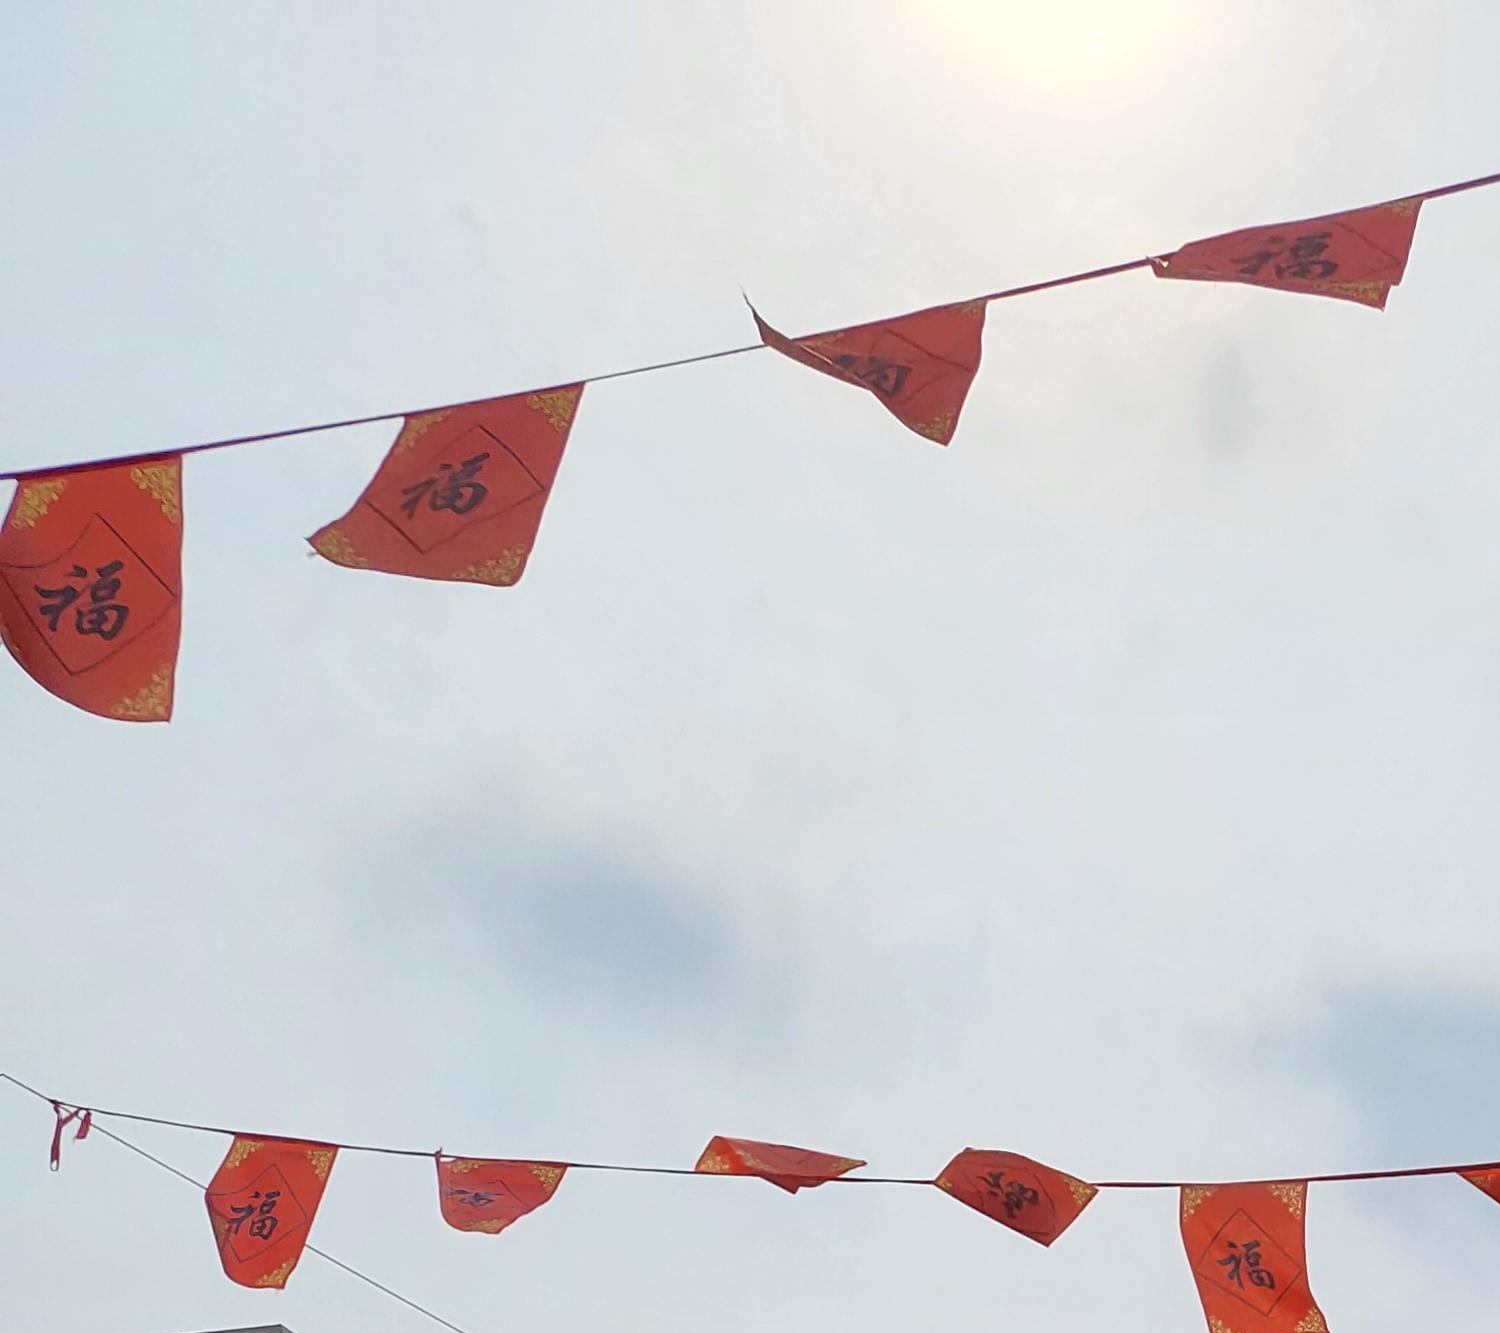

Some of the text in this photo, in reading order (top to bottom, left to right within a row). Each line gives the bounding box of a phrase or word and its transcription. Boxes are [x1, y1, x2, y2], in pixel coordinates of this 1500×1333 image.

[400, 451, 490, 520] 福
[34, 560, 129, 641] 福
[228, 1191, 281, 1241] 福
[1217, 1241, 1276, 1291] 福
